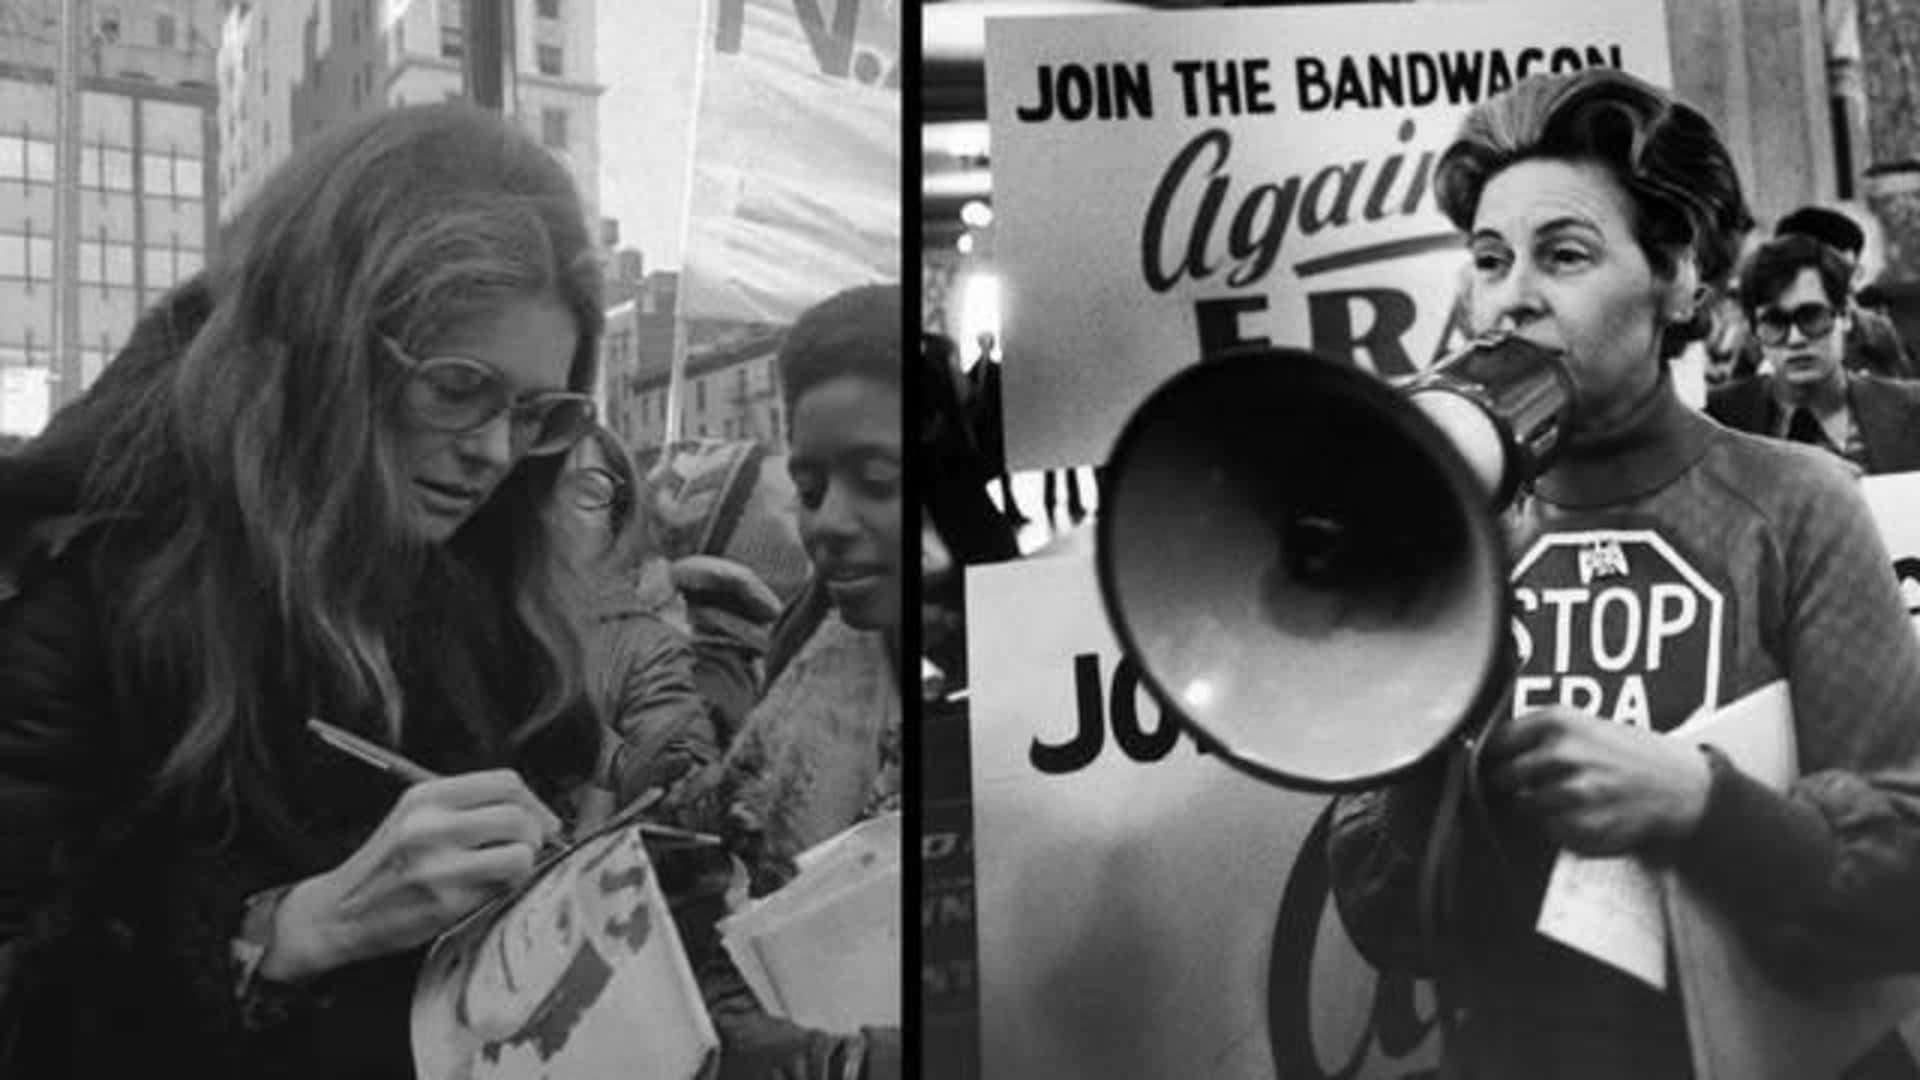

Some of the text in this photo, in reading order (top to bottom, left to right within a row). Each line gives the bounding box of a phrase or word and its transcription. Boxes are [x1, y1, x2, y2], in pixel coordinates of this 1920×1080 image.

[1017, 62, 1153, 123] JOIN
[1172, 58, 1276, 117] THE
[1195, 288, 1462, 379] ER
[1029, 653, 1216, 774] JO
